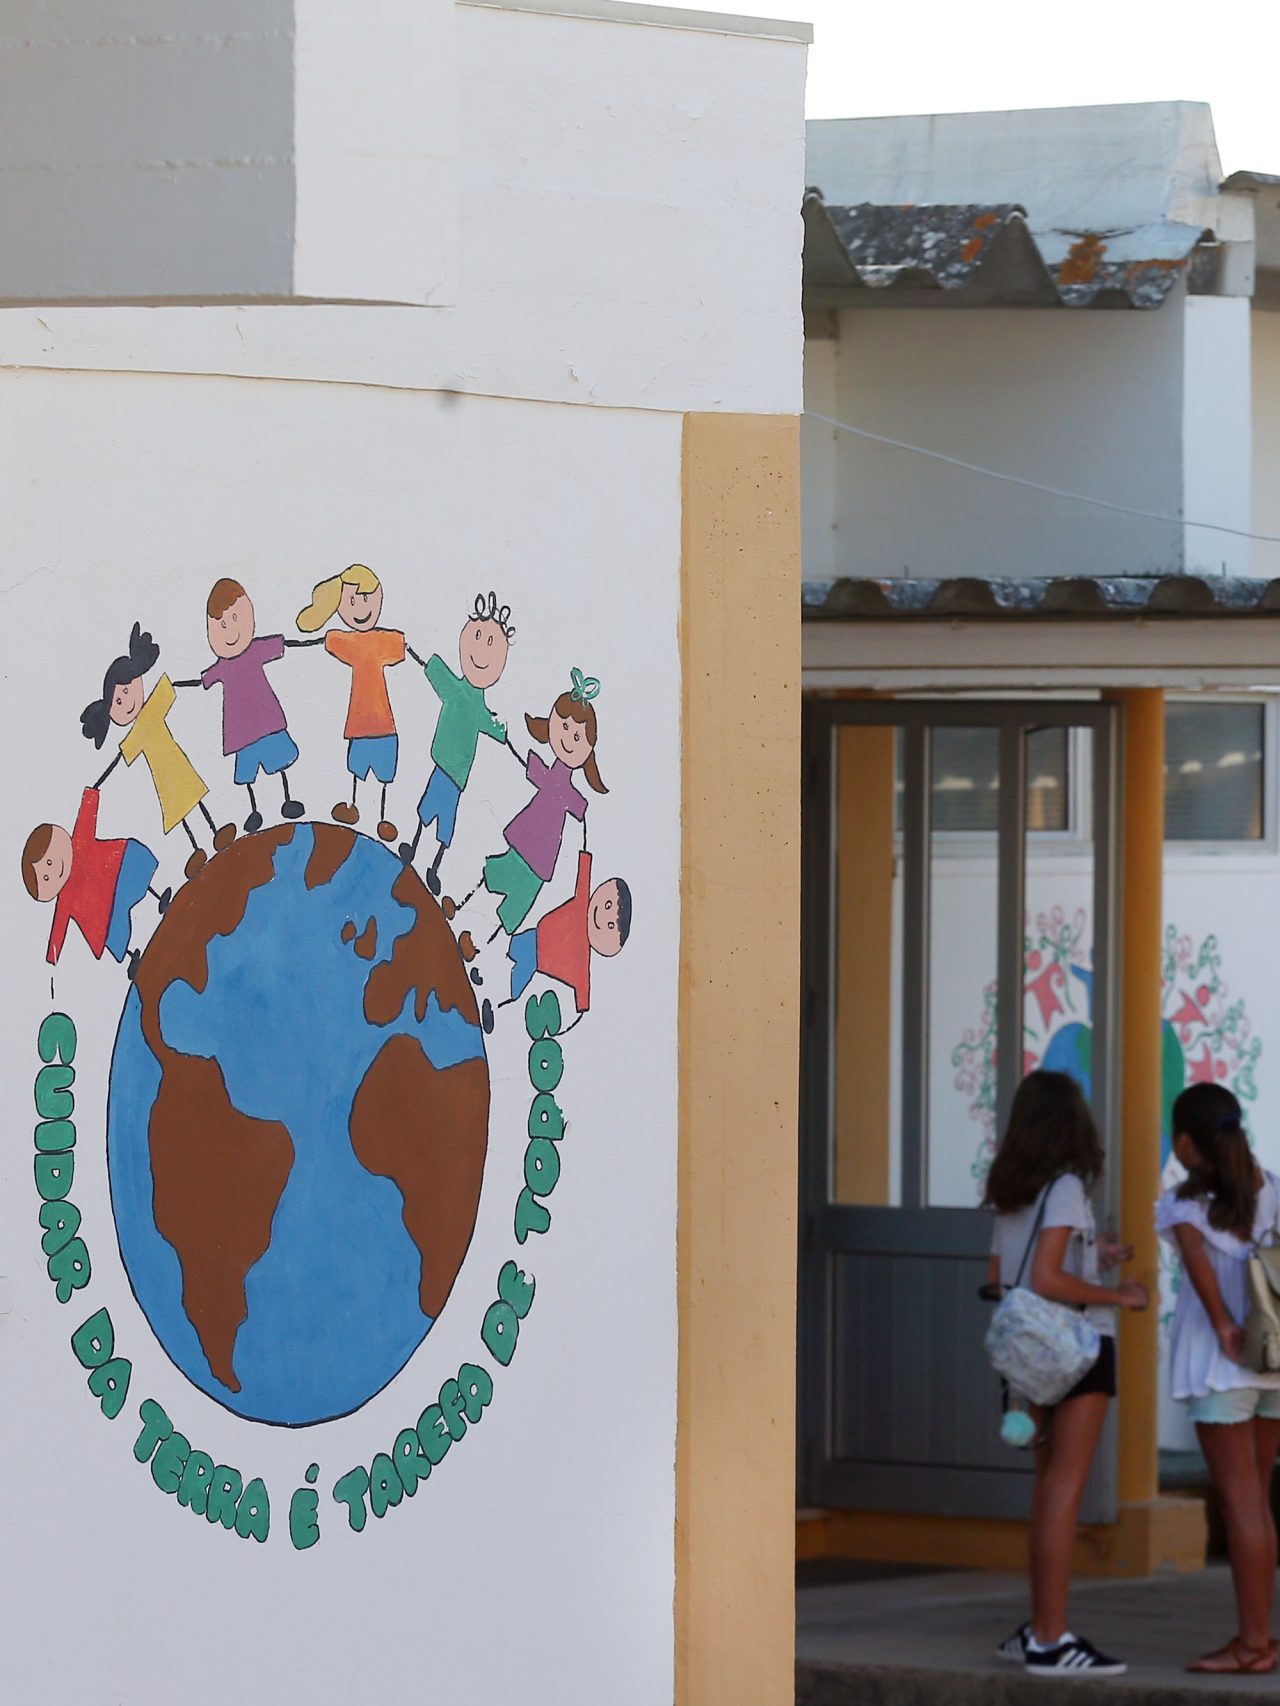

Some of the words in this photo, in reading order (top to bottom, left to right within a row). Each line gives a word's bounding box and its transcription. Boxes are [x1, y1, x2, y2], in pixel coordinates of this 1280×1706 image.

[34, 1012, 91, 1304] CUIDAR
[71, 1306, 132, 1420] DA
[133, 1398, 270, 1543] TERRA
[289, 1463, 320, 1551] É
[333, 1363, 494, 1533] TAREFA
[481, 1260, 536, 1367] DE
[514, 989, 570, 1245] TODOS
